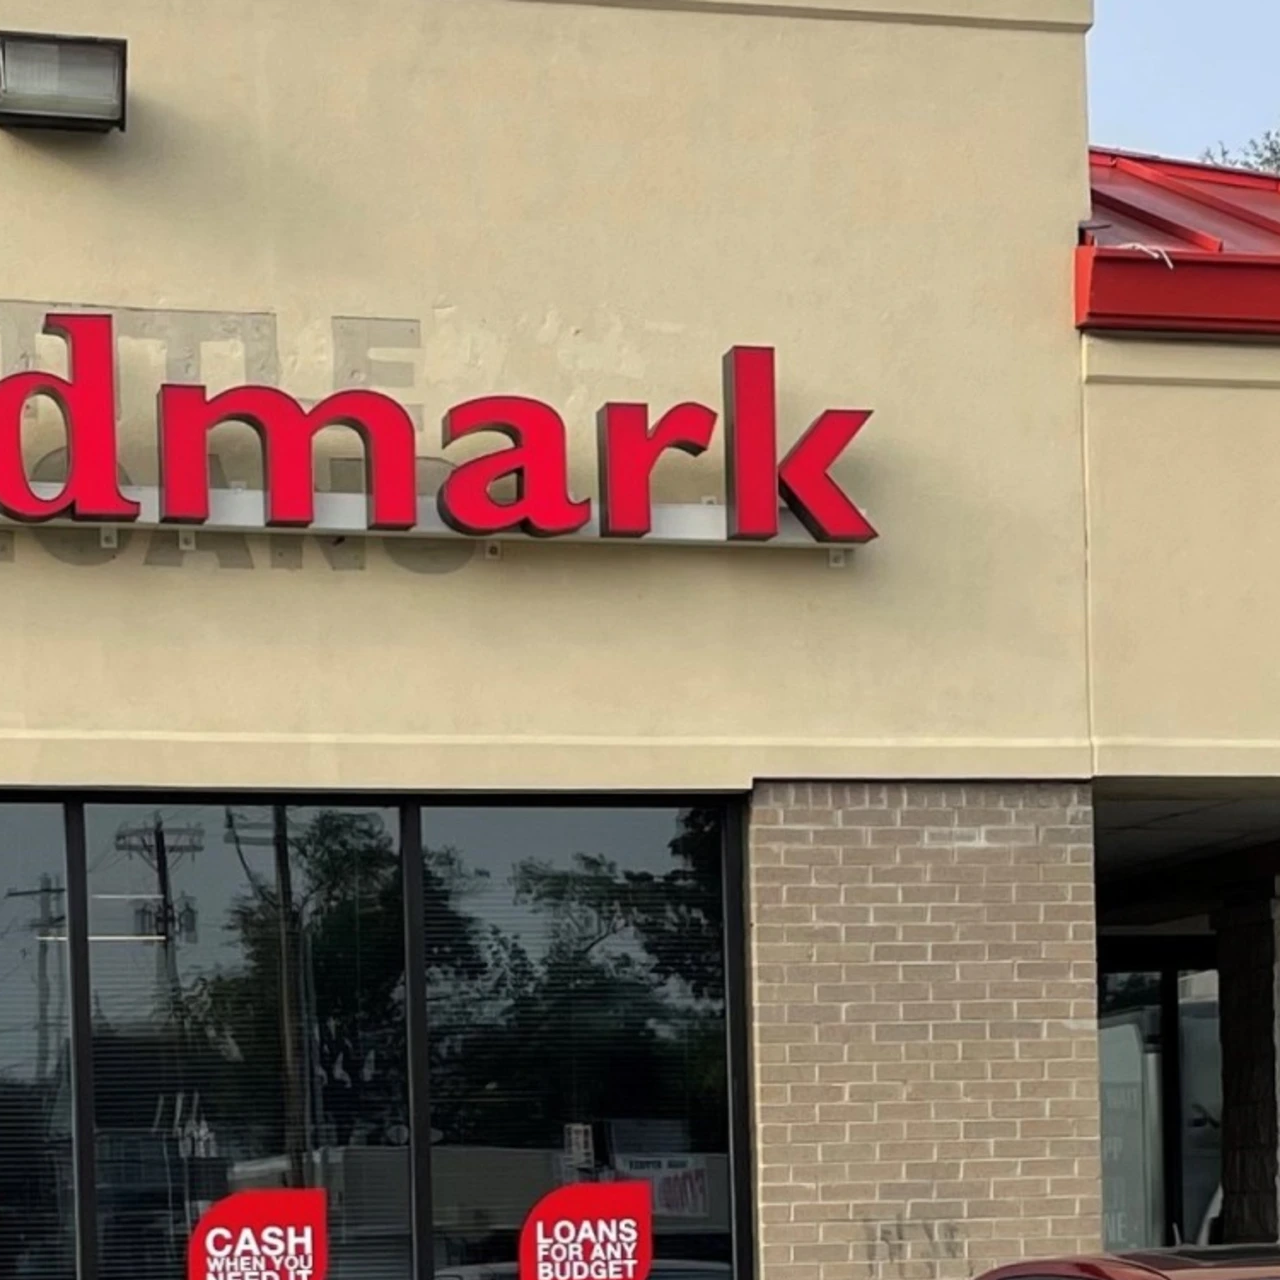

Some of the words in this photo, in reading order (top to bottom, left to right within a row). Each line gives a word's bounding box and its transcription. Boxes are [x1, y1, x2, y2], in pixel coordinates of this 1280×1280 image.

[204, 1226, 314, 1258] CASH
[536, 1218, 639, 1246] LOANS
[207, 1256, 266, 1272] WHEN
[272, 1254, 313, 1271] YOU
[537, 1244, 583, 1262] FOR
[590, 1241, 637, 1260] ANY
